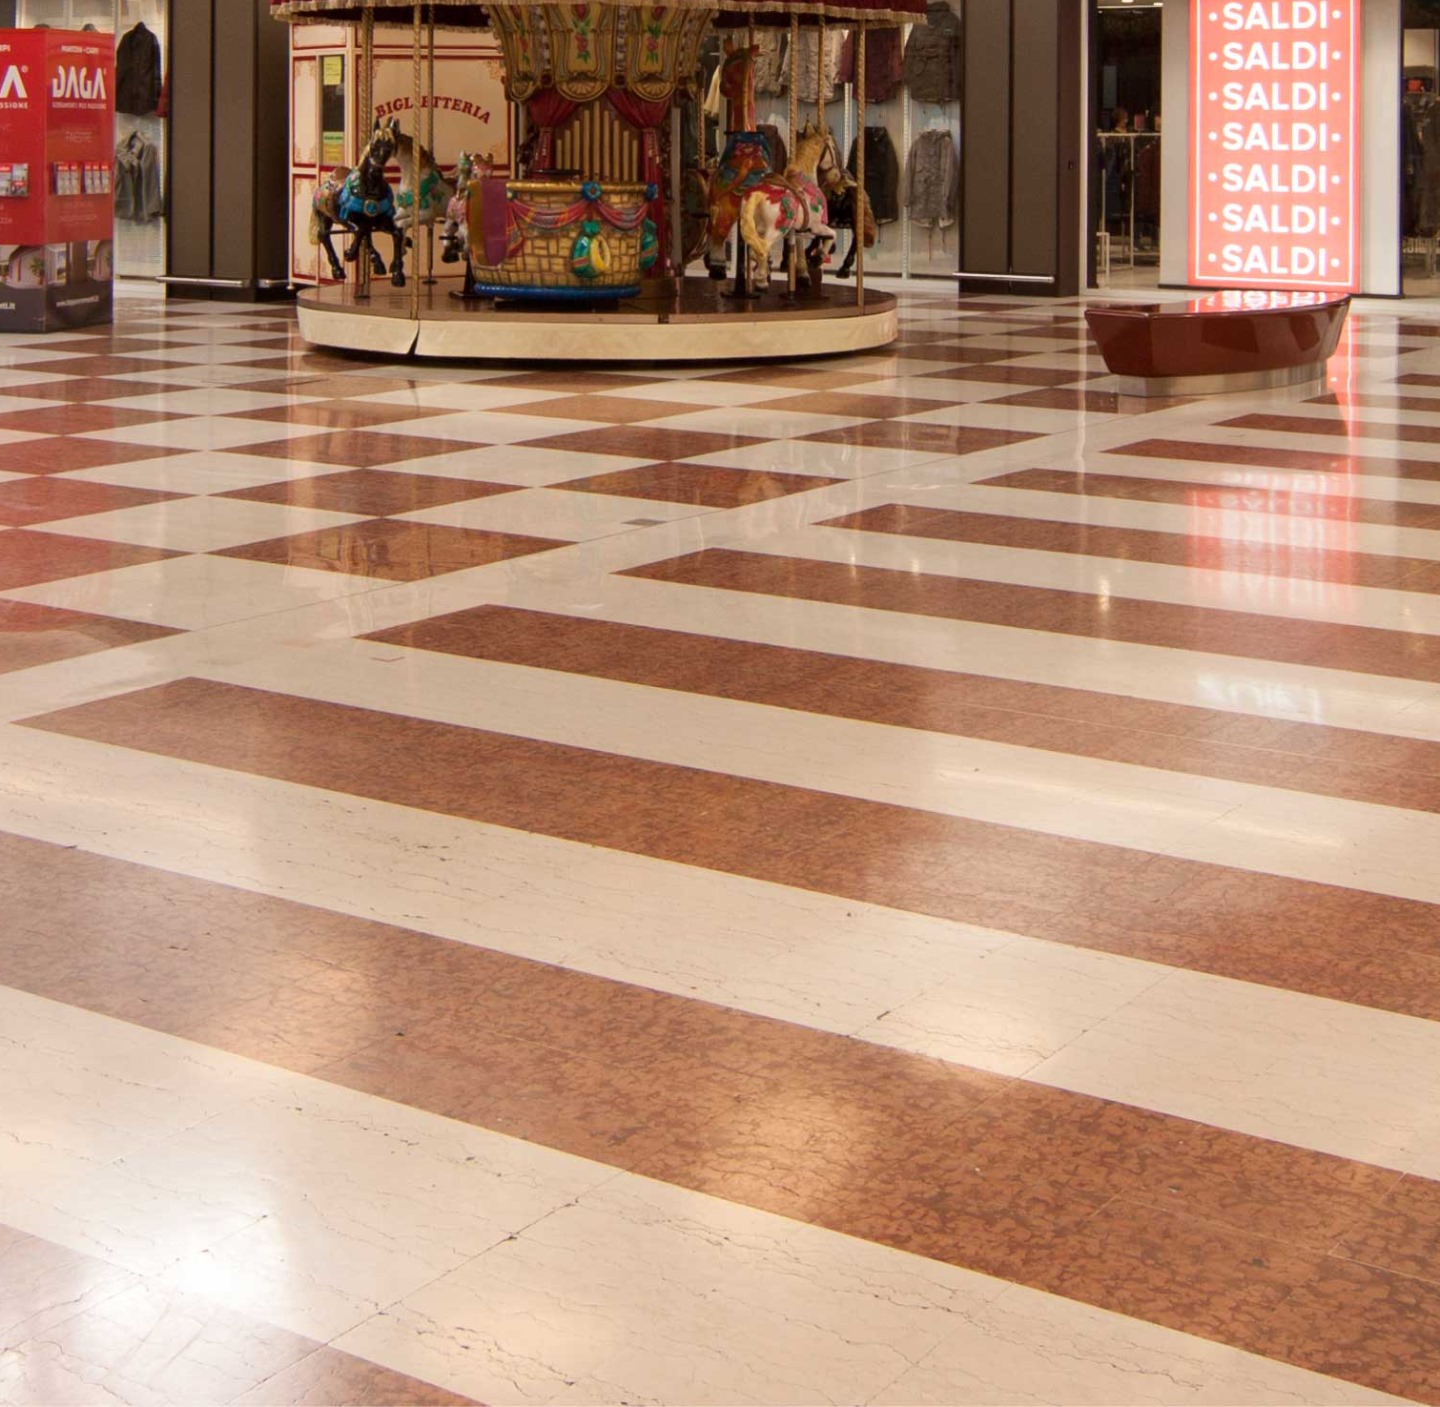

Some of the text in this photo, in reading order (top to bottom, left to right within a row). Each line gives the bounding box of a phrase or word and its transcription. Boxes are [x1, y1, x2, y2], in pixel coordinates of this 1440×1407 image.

[1222, 0, 1328, 31] SALDI
[1222, 41, 1328, 70] SALDI
[52, 65, 107, 100] DAGA
[1222, 81, 1328, 111] SALDI
[374, 95, 492, 125] BIGLETTERIA
[1222, 122, 1328, 152] SALDI
[1222, 163, 1328, 194] SALDI
[1222, 203, 1328, 235] SALDI
[1222, 244, 1328, 276] SALDI
